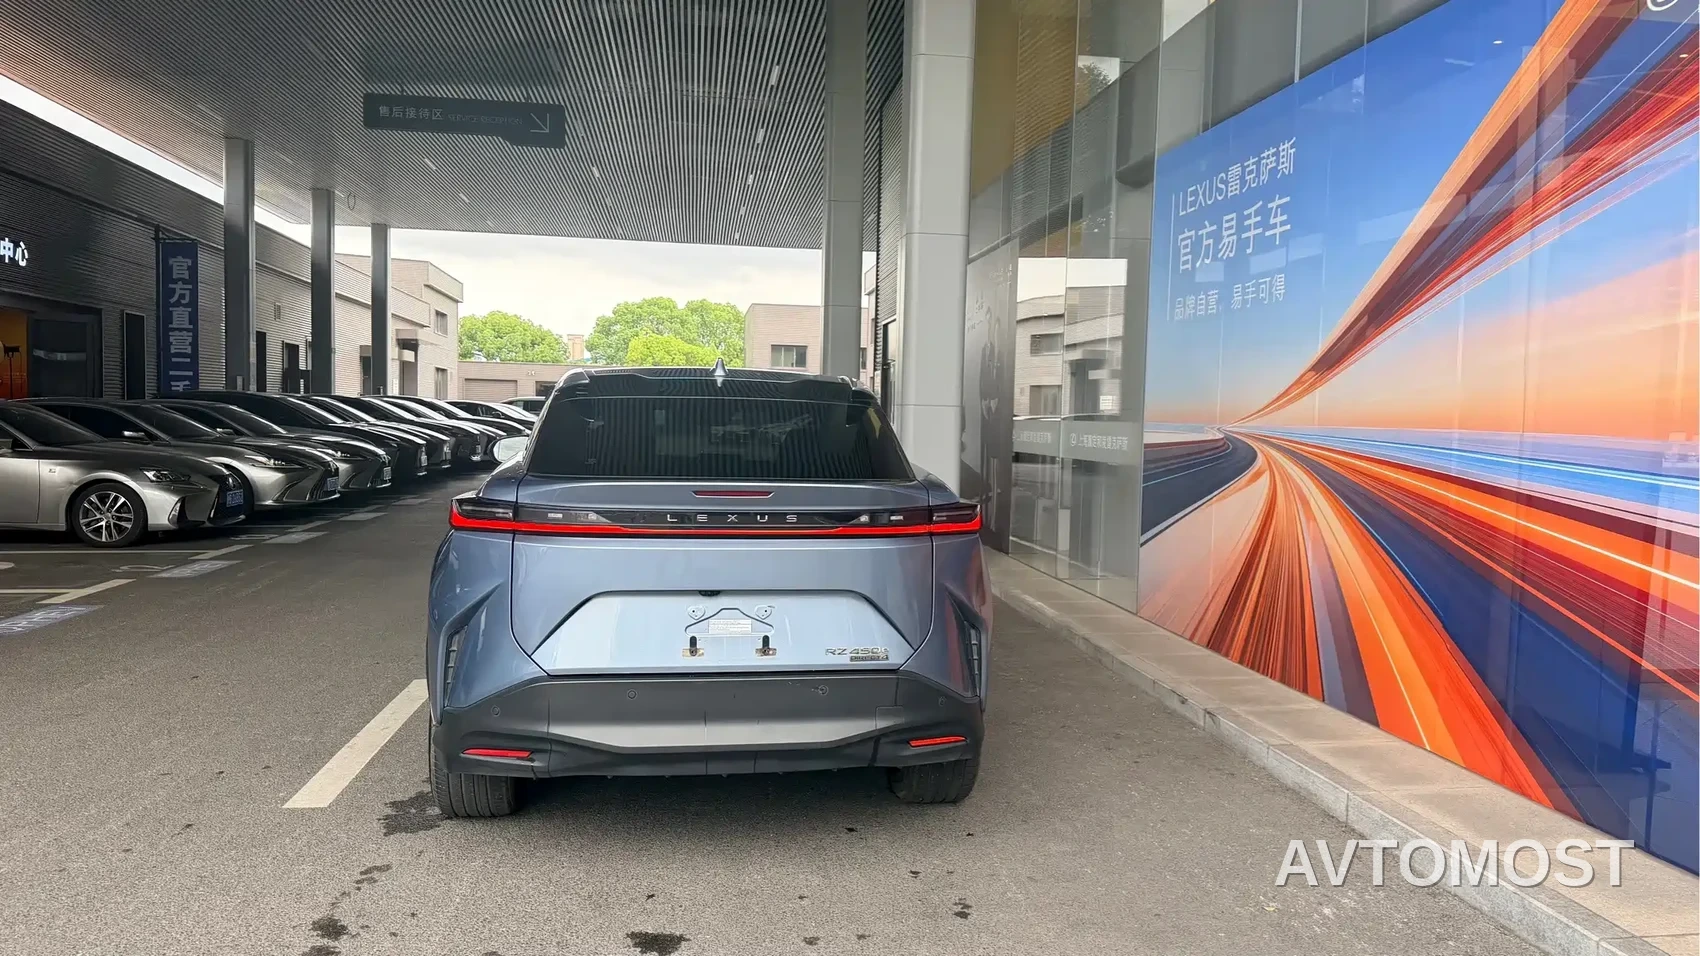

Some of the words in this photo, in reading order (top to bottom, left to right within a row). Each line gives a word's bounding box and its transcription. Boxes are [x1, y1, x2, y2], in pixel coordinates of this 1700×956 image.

[379, 105, 443, 120] 售后接待区
[1179, 137, 1296, 216] LEXUS雷克萨斯
[1178, 194, 1291, 273] 官方易手车
[0, 237, 29, 267] 中心
[667, 514, 798, 523] LEXUS
[825, 648, 847, 656] RZ
